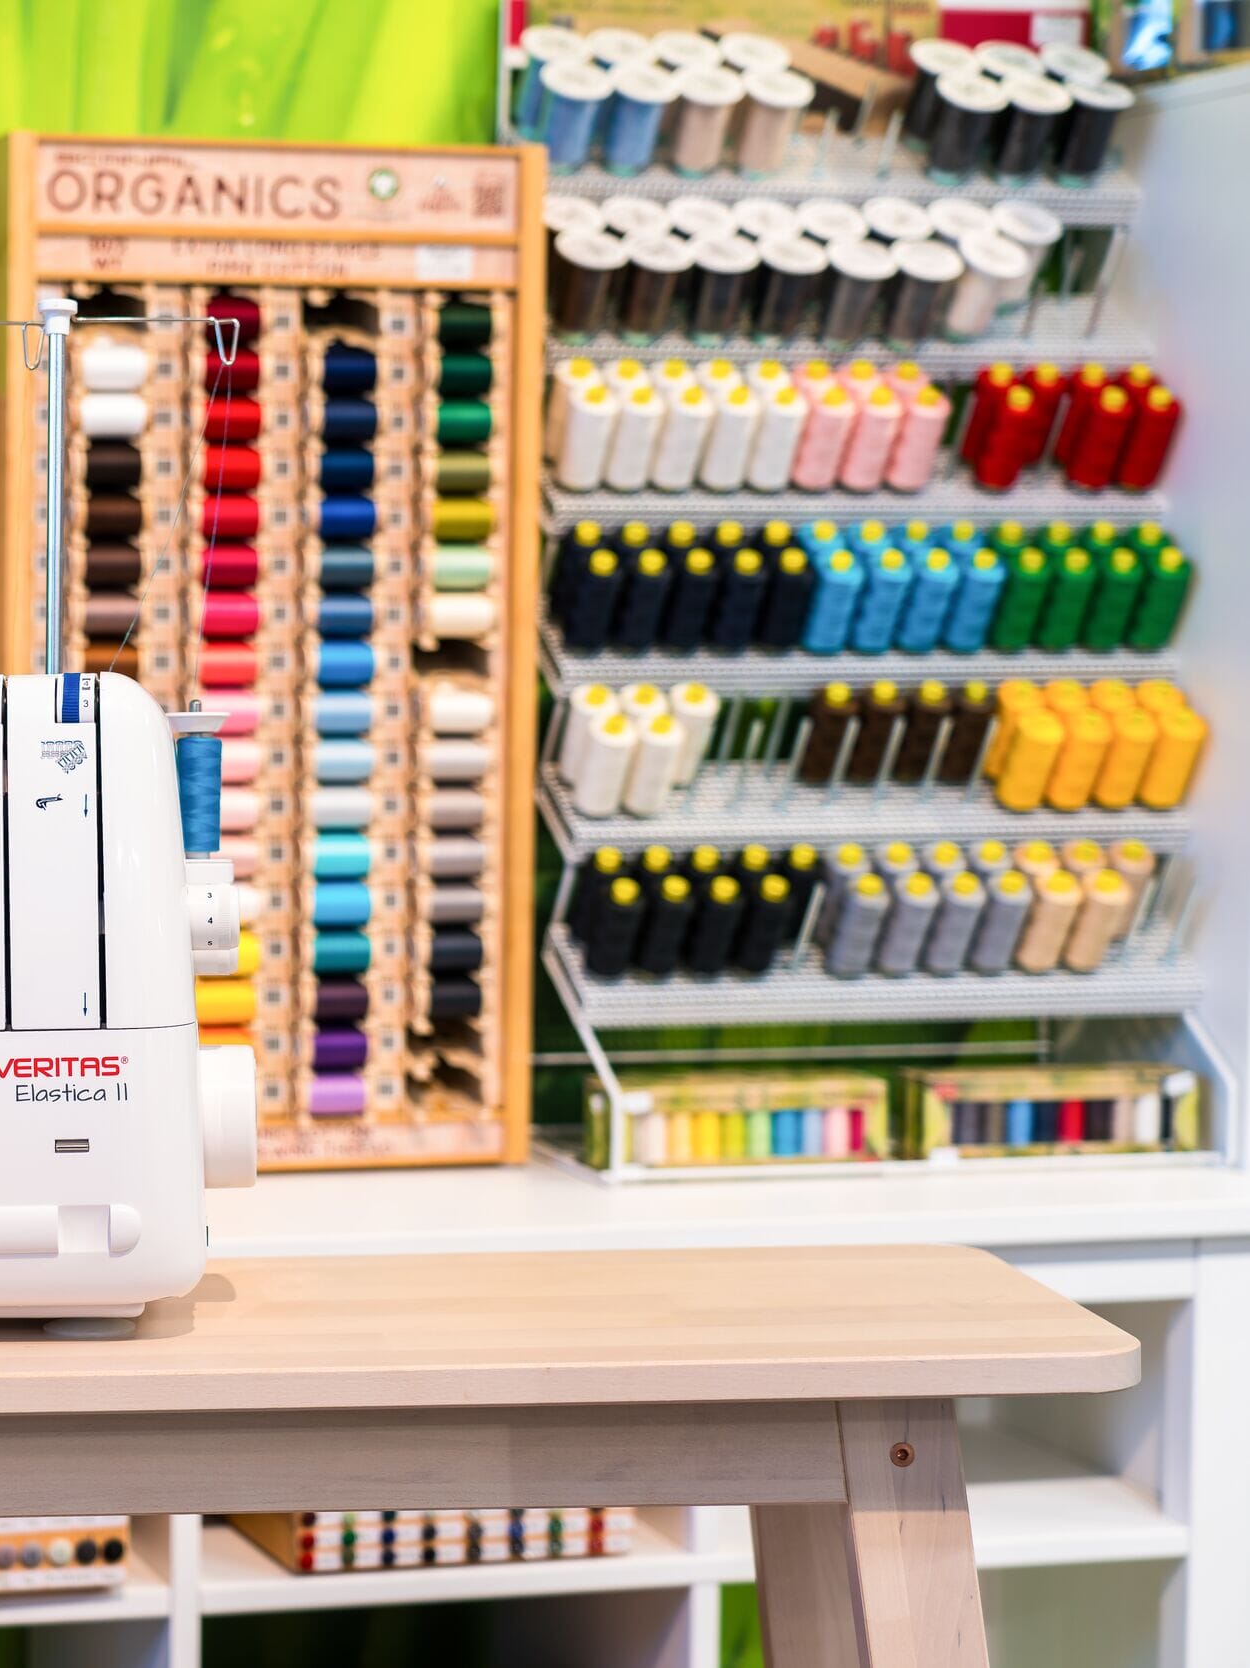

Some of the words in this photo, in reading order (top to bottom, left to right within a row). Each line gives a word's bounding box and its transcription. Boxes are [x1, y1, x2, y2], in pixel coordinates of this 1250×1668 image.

[47, 169, 342, 221] ORGANICS
[83, 700, 89, 708] 3
[15, 1083, 107, 1103] Elastica
